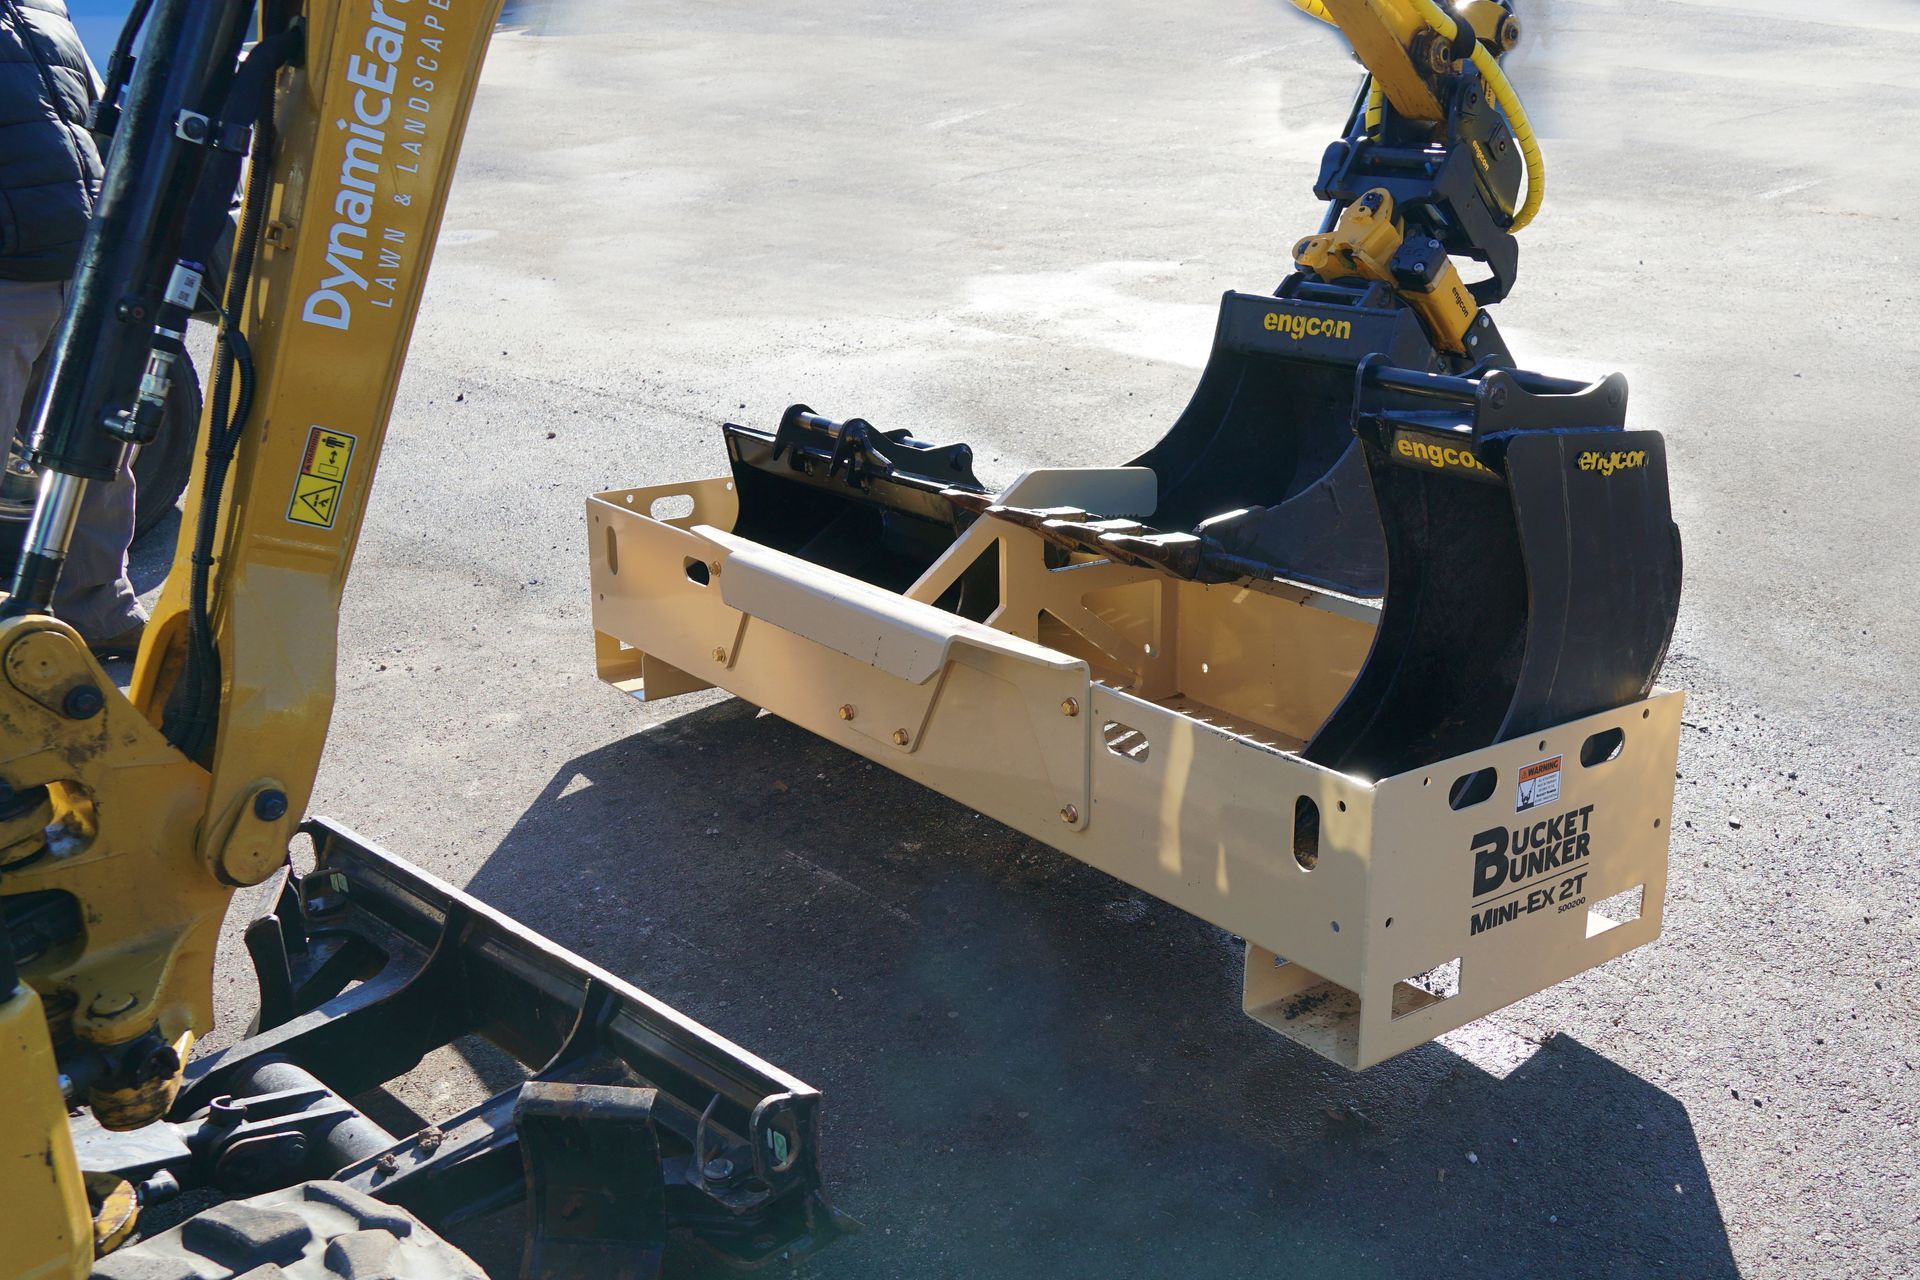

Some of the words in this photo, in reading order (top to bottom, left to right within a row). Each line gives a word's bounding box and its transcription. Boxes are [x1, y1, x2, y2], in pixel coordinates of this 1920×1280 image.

[302, 0, 411, 330] DynamicEar
[1472, 140, 1490, 171] engcon
[371, 228, 406, 308] LAWN
[393, 194, 412, 207] &
[1452, 287, 1469, 317] engcon
[1263, 312, 1351, 340] engcon
[1397, 440, 1492, 472] engco
[1528, 760, 1559, 776] WARNING
[1470, 804, 1594, 862] BUCKET
[1472, 831, 1590, 897] BUNKER
[1470, 886, 1555, 936] MINI-EX
[1559, 871, 1588, 901] 2T
[1557, 896, 1586, 914] 500200
